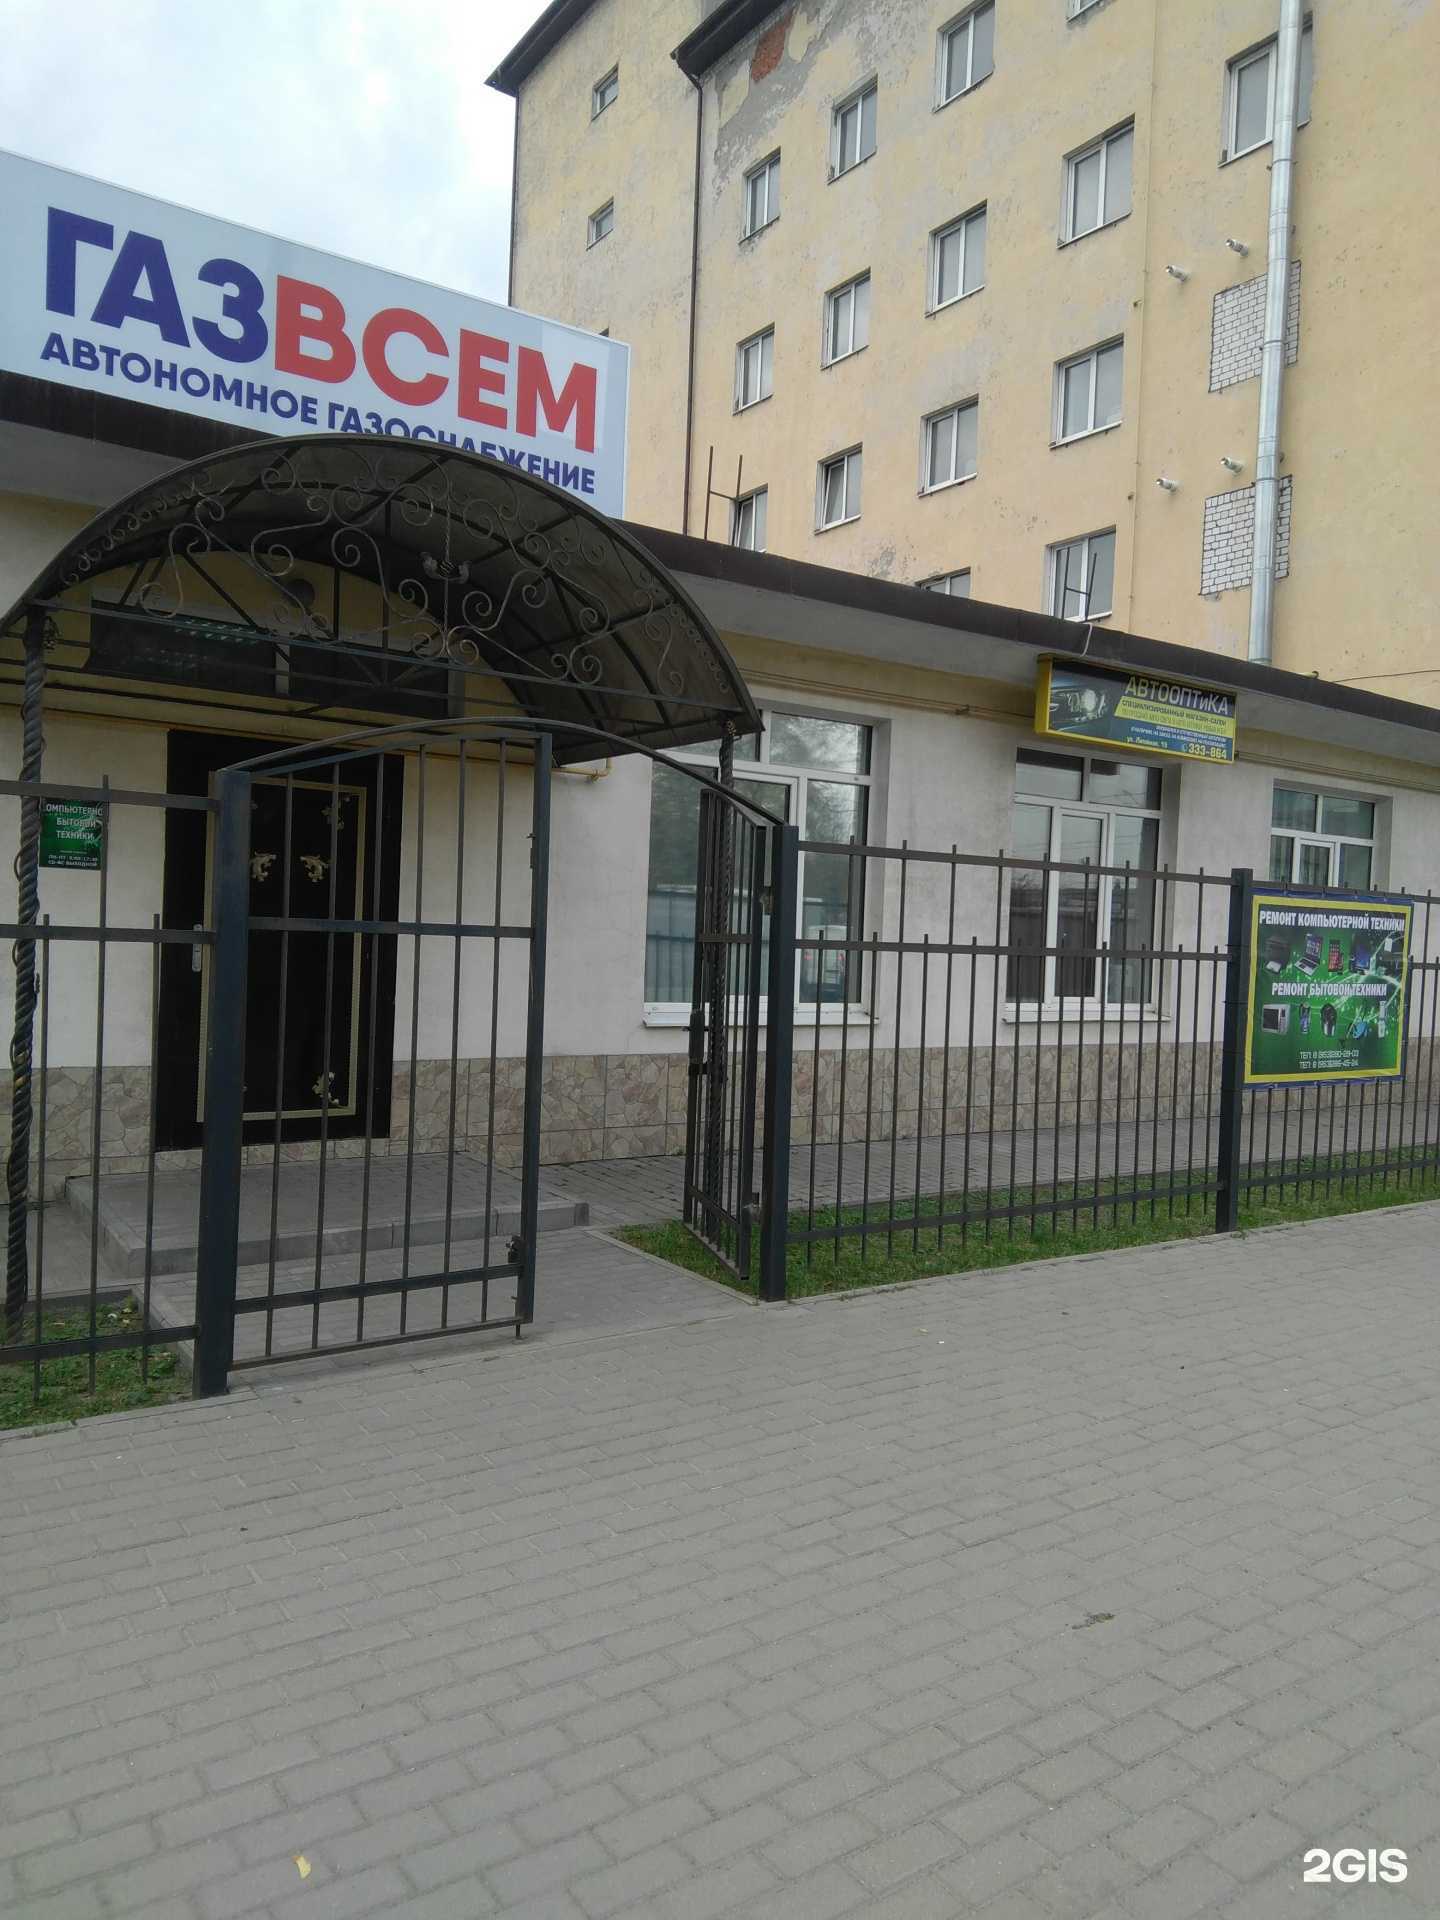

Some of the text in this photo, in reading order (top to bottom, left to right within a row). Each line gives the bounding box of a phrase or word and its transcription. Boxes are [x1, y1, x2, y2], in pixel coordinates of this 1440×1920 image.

[40, 332, 318, 425] АВТОНОМНОЕ
[1259, 910, 1405, 932] РЕМОНТ КОМПЬЮТЕРНОЙ ТЕХНИКИ
[1271, 982, 1308, 996] РЕМОНТ
[1350, 983, 1387, 996] ТЕХНИКИ
